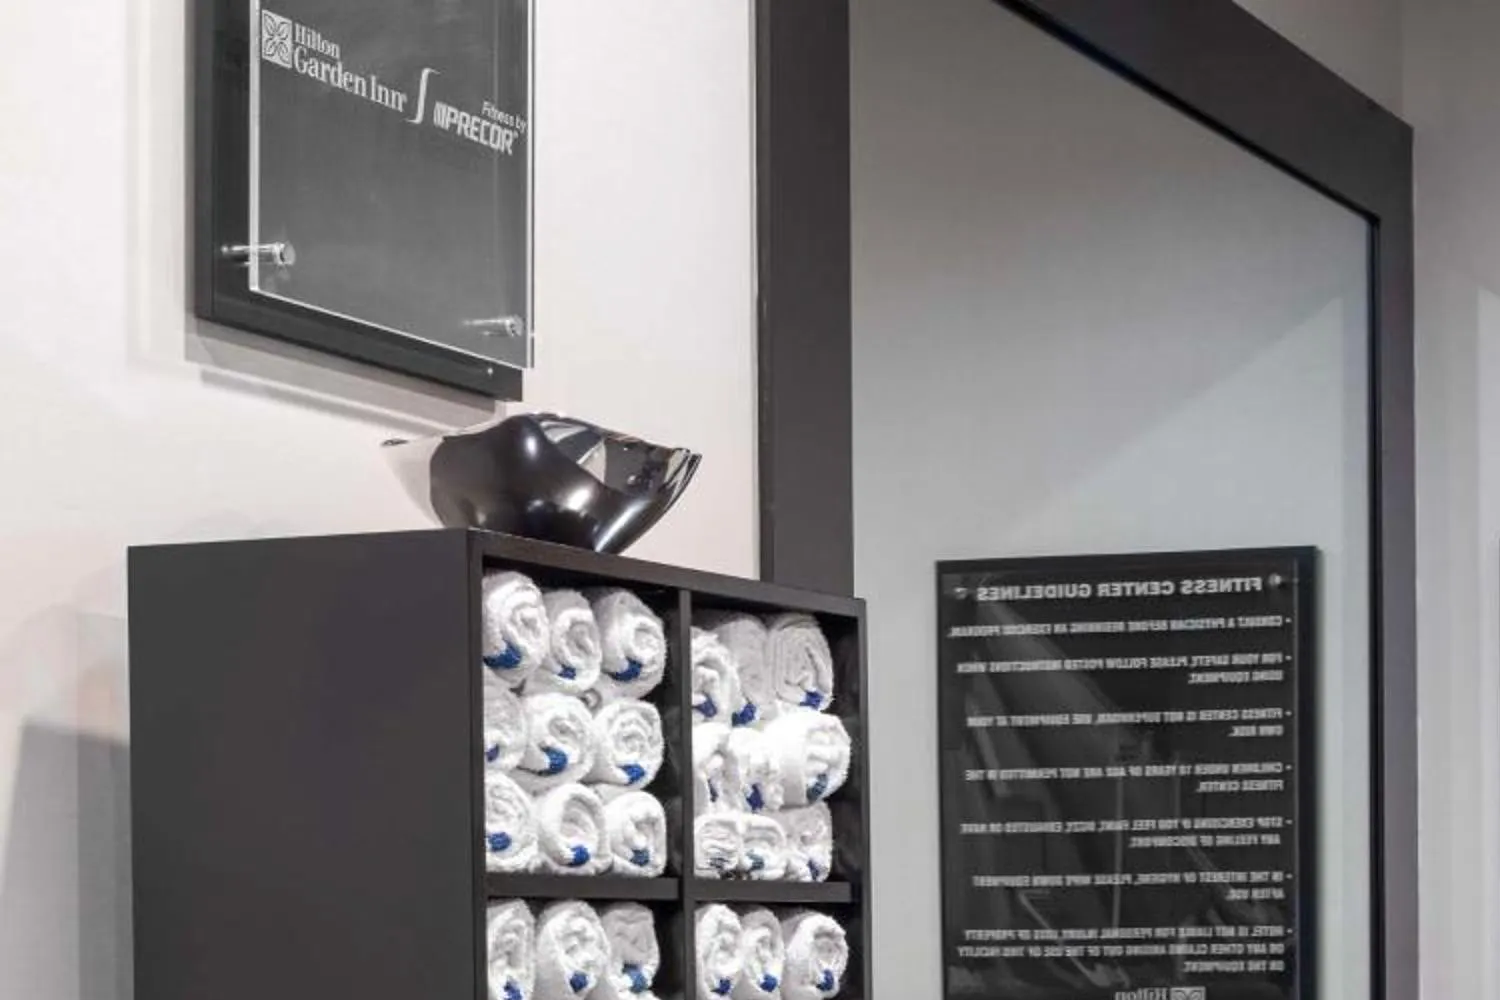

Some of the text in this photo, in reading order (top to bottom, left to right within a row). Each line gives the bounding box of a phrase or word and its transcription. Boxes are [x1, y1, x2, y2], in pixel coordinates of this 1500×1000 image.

[295, 23, 340, 59] Hilton
[294, 46, 404, 112] Garden Inn
[447, 106, 513, 156] PRECOR
